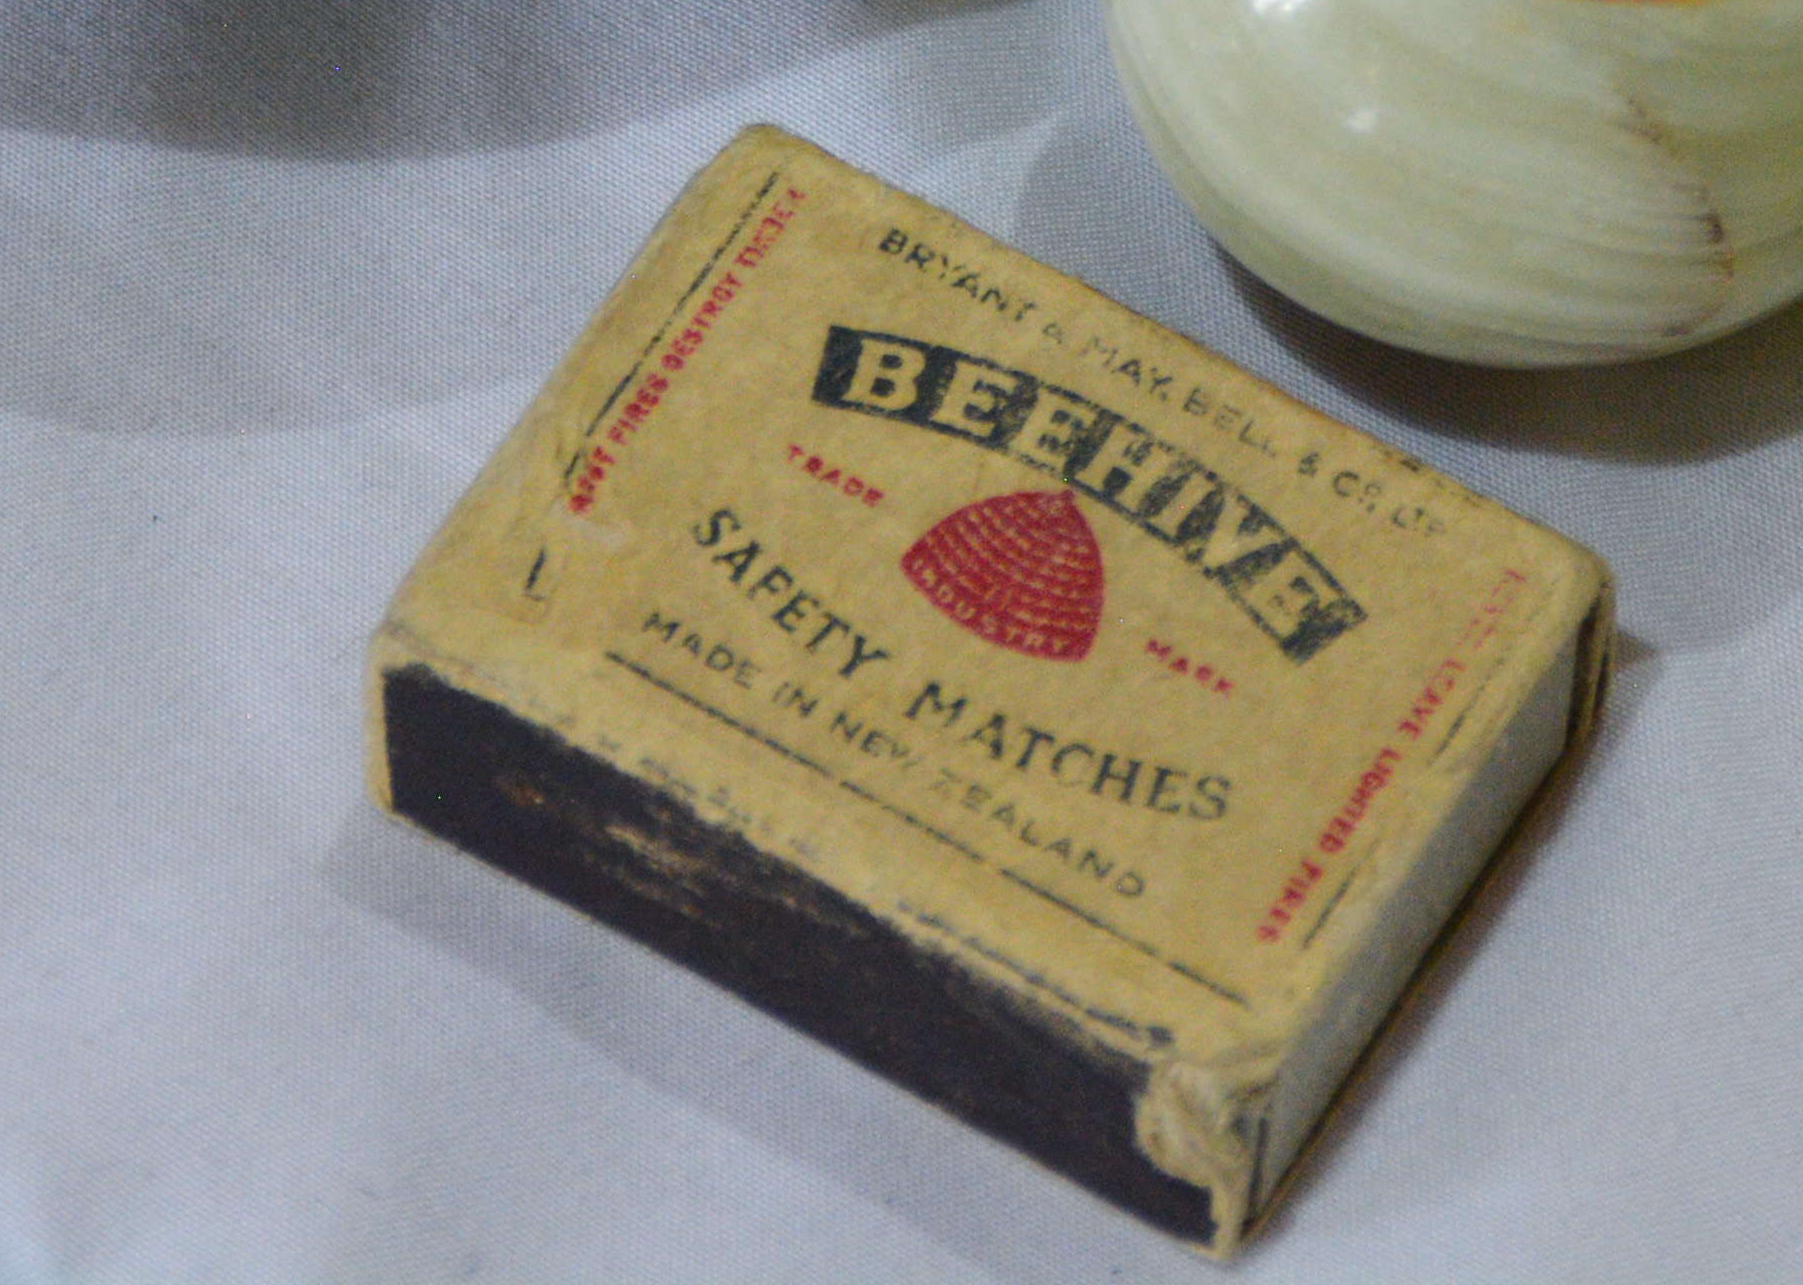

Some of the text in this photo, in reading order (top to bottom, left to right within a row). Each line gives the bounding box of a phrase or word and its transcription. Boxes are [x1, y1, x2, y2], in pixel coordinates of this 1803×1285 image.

[879, 228, 1038, 322] BRYANT
[606, 371, 670, 446] FIRES
[660, 271, 743, 373] DESTROY
[787, 443, 885, 508] TRADE
[836, 333, 1351, 647] BEEHIVE
[693, 508, 891, 678] SAFETY
[902, 680, 1232, 821] MATCHES
[1145, 637, 1235, 698] MARK
[1398, 657, 1465, 740] LEAVE
[642, 611, 1145, 897] MADE IN NEW ZEALAND
[1318, 747, 1402, 855] LIGHTED
[1256, 858, 1325, 943] FIRES
